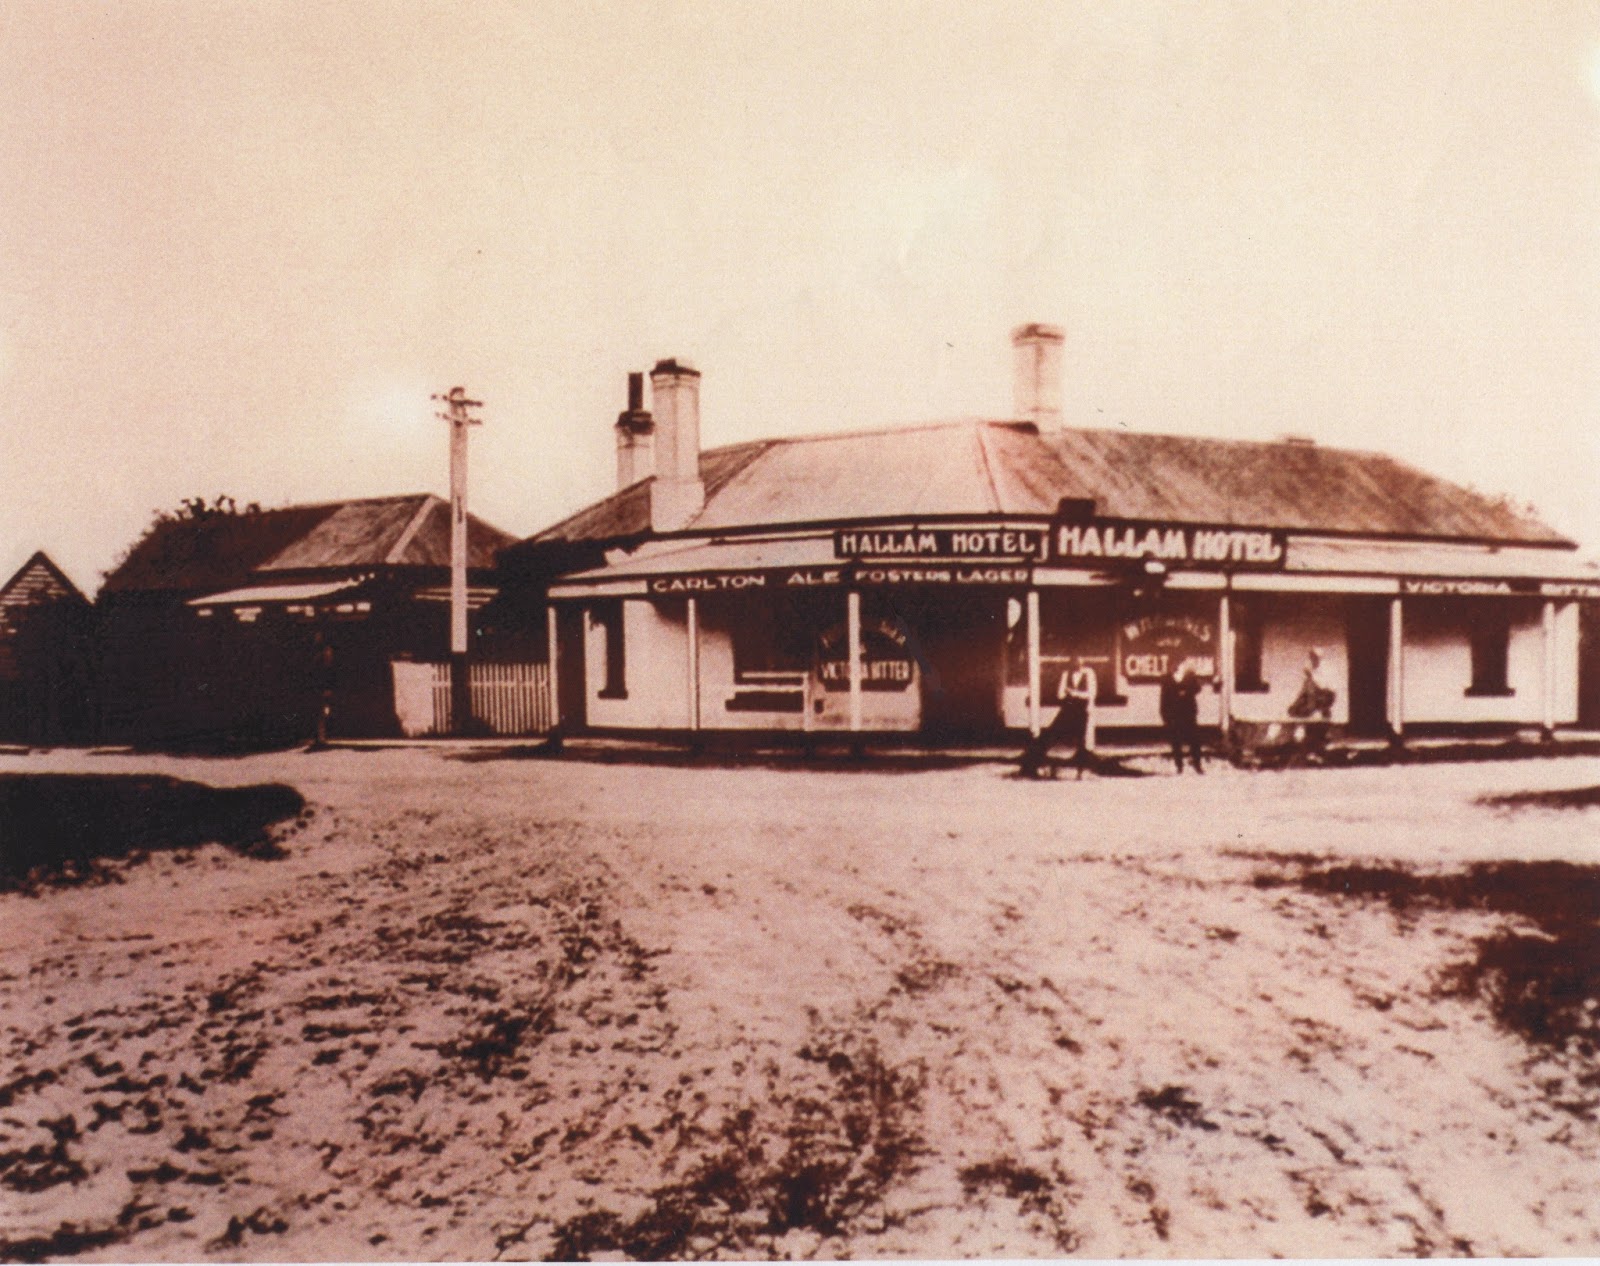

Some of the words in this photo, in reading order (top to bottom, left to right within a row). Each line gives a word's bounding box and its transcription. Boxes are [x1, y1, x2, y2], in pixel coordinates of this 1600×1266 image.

[841, 532, 938, 554] HALLAM
[953, 529, 1036, 553] HOTEL
[1058, 526, 1187, 559] HALLAM
[1192, 530, 1281, 562] HOTEL
[652, 575, 766, 593] CARLTON
[787, 571, 840, 585] ALE
[956, 570, 1028, 583] LAGER
[1405, 581, 1512, 595] VICTORIA
